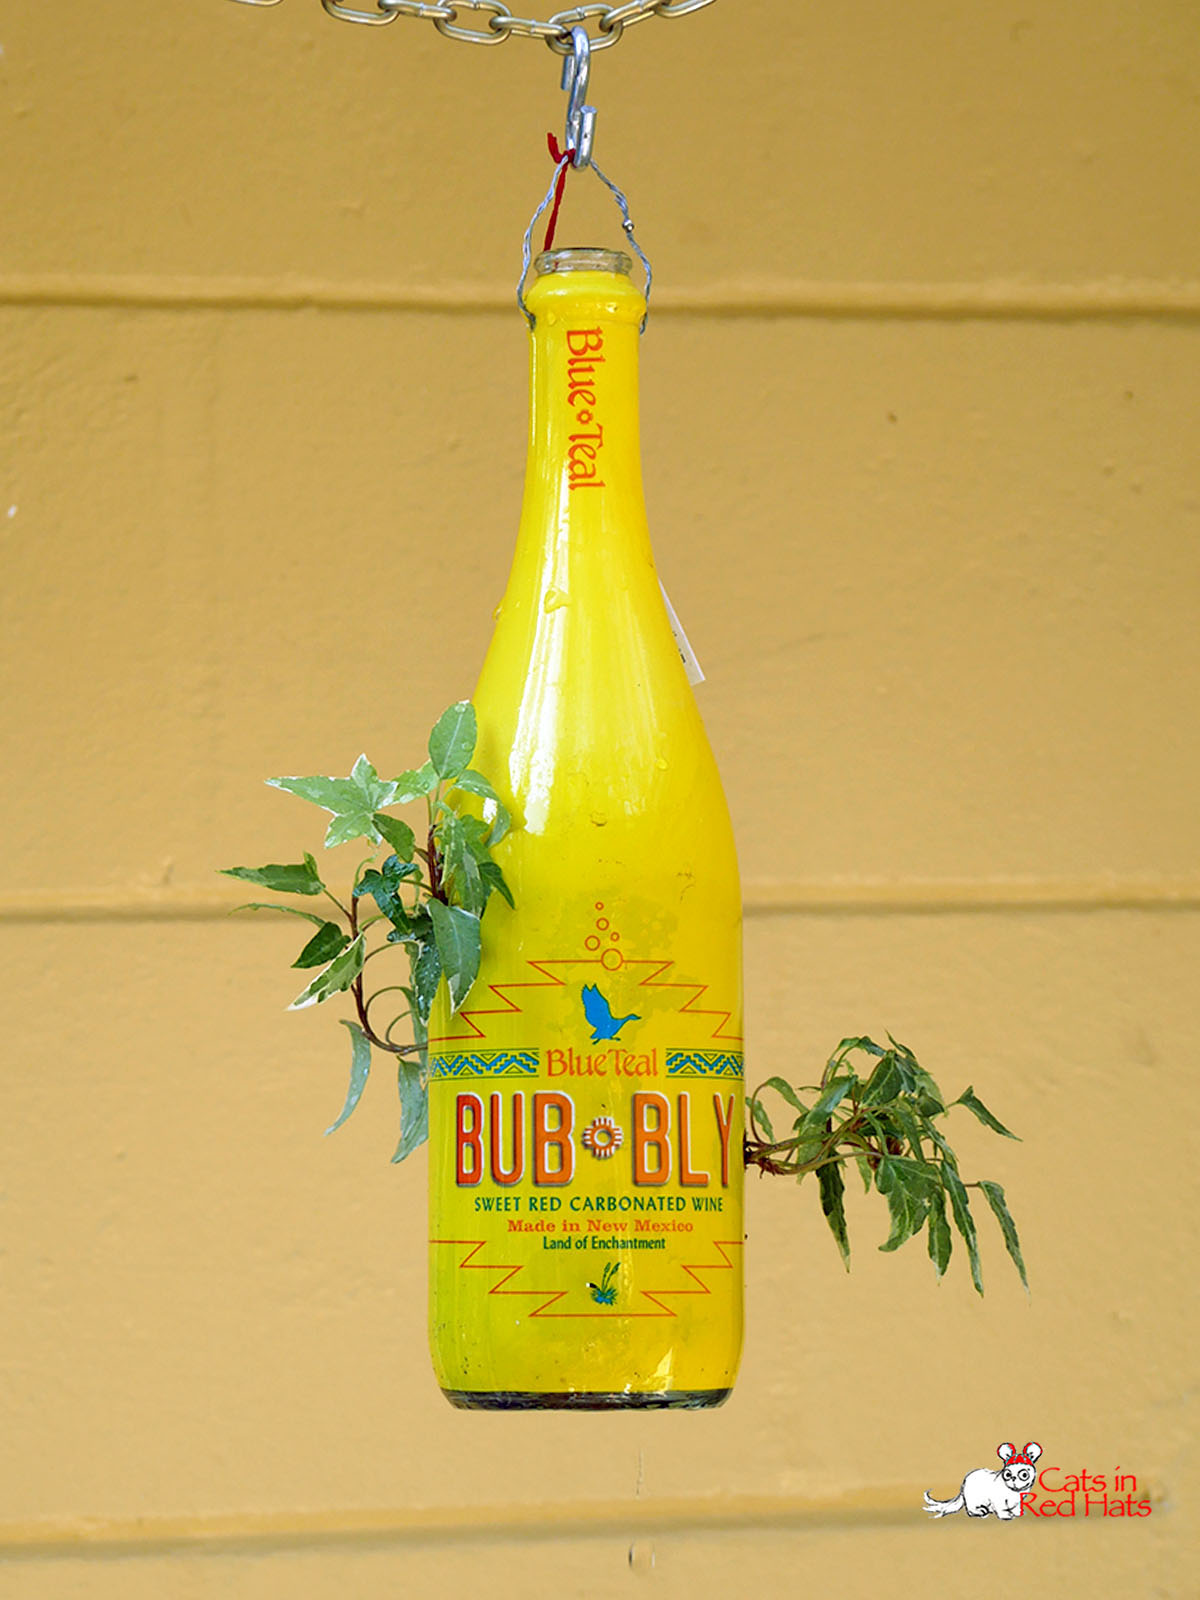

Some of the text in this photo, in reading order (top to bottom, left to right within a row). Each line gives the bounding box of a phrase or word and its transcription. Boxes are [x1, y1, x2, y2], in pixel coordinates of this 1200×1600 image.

[566, 326, 606, 491] Blue Teal
[546, 1048, 659, 1077] Blue Teal
[456, 1090, 736, 1188] BUB BLY
[474, 1196, 724, 1212] SWEET RED CARBONATED WINE
[507, 1219, 694, 1233] Made in New Mexico
[542, 1235, 666, 1250] Land of Enchantment
